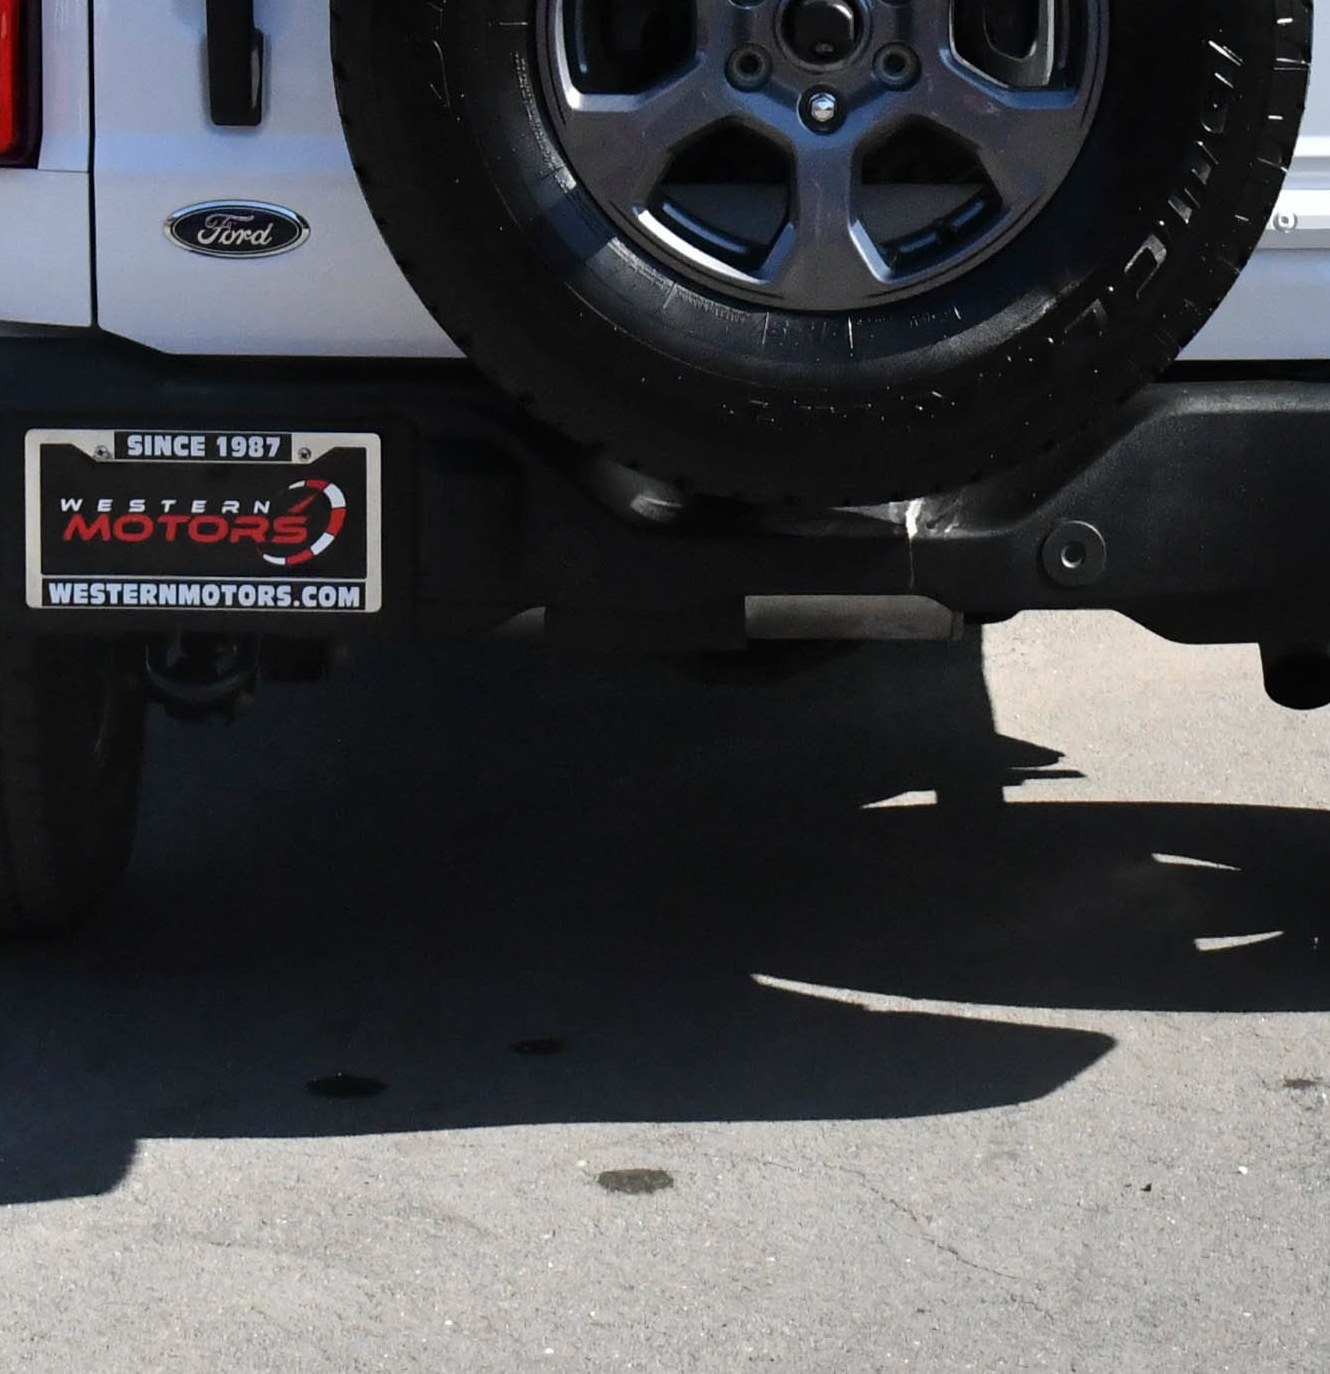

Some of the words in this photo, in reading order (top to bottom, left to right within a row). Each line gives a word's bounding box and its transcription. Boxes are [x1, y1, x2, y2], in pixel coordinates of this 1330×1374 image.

[197, 213, 274, 245] Ford
[127, 434, 206, 457] SINCE
[217, 435, 281, 458] 1987
[60, 498, 270, 514] WESTERN
[62, 514, 310, 544] MOTORS
[48, 581, 361, 608] WESTERNMOTORS.COM
